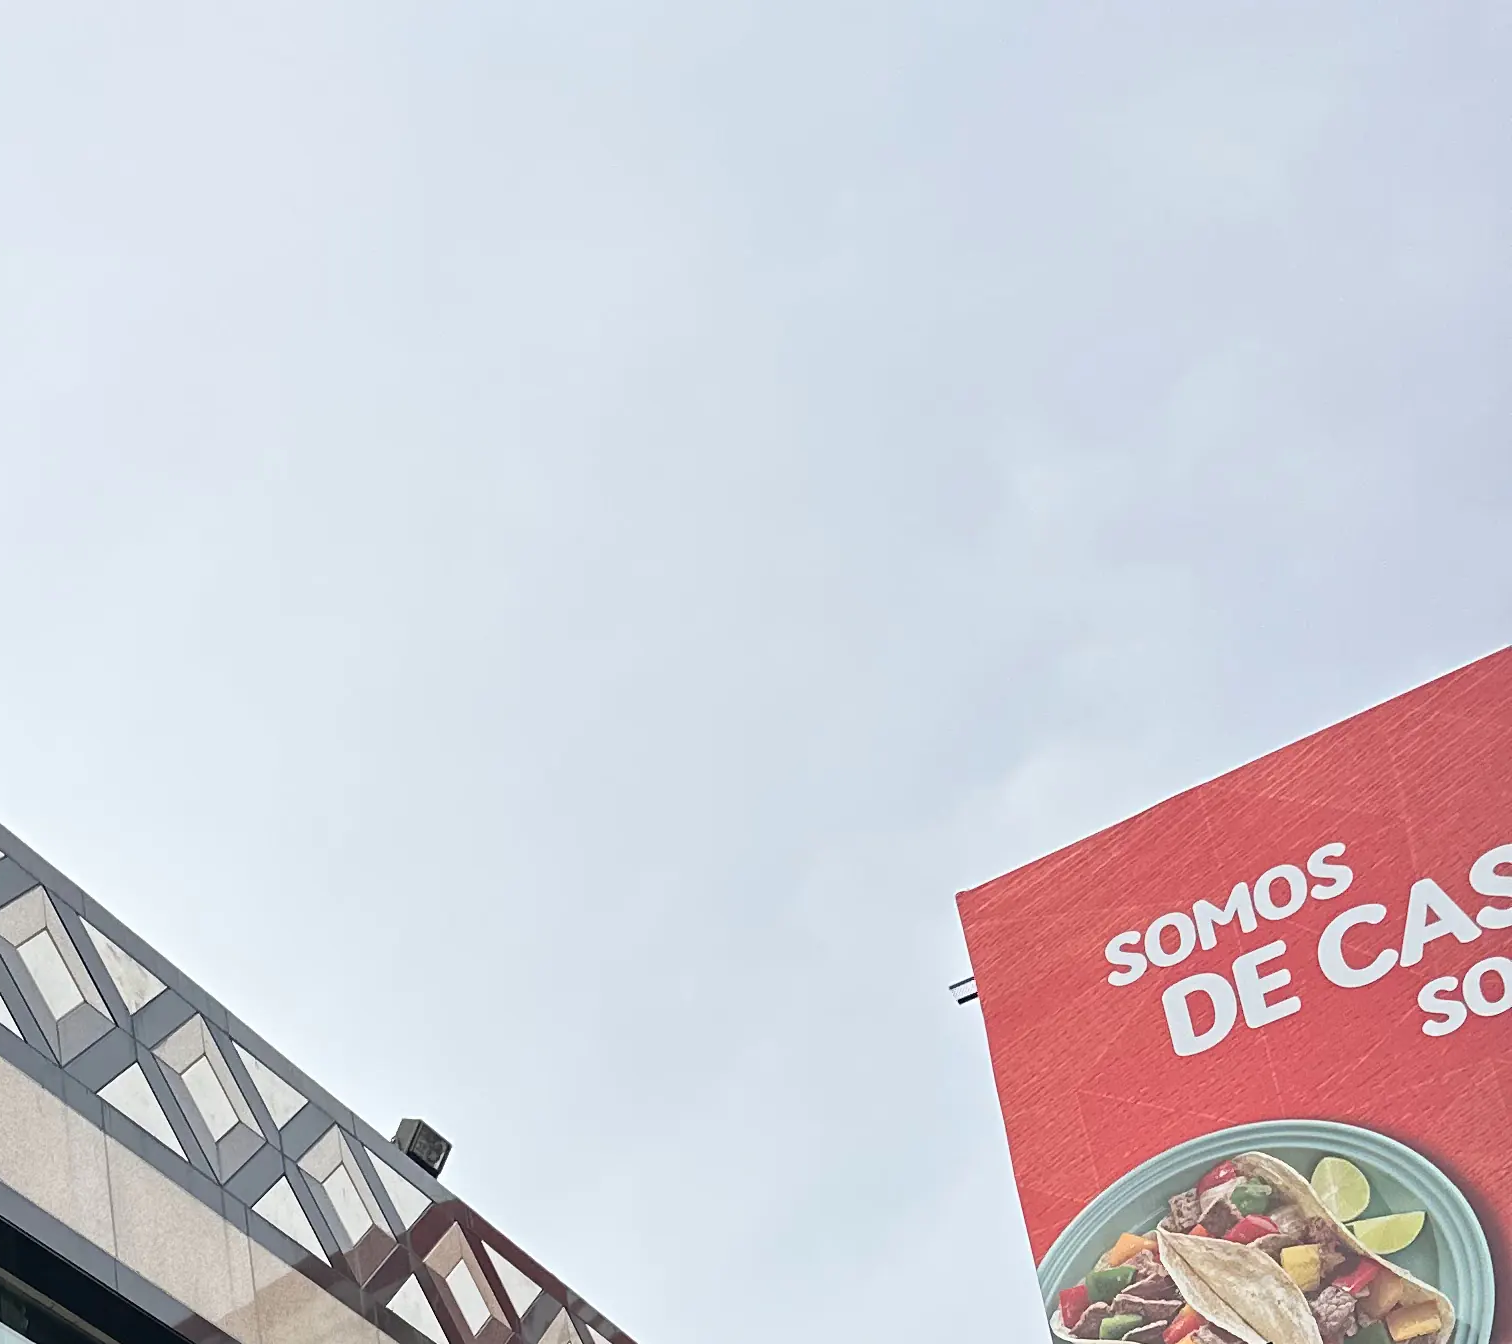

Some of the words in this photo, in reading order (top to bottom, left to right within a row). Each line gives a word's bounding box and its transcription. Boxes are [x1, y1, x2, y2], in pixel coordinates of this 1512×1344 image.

[1105, 842, 1353, 986] SOMOS
[1161, 940, 1302, 1057] DE
[1317, 843, 1512, 988] CAS
[1417, 956, 1512, 1037] SO
